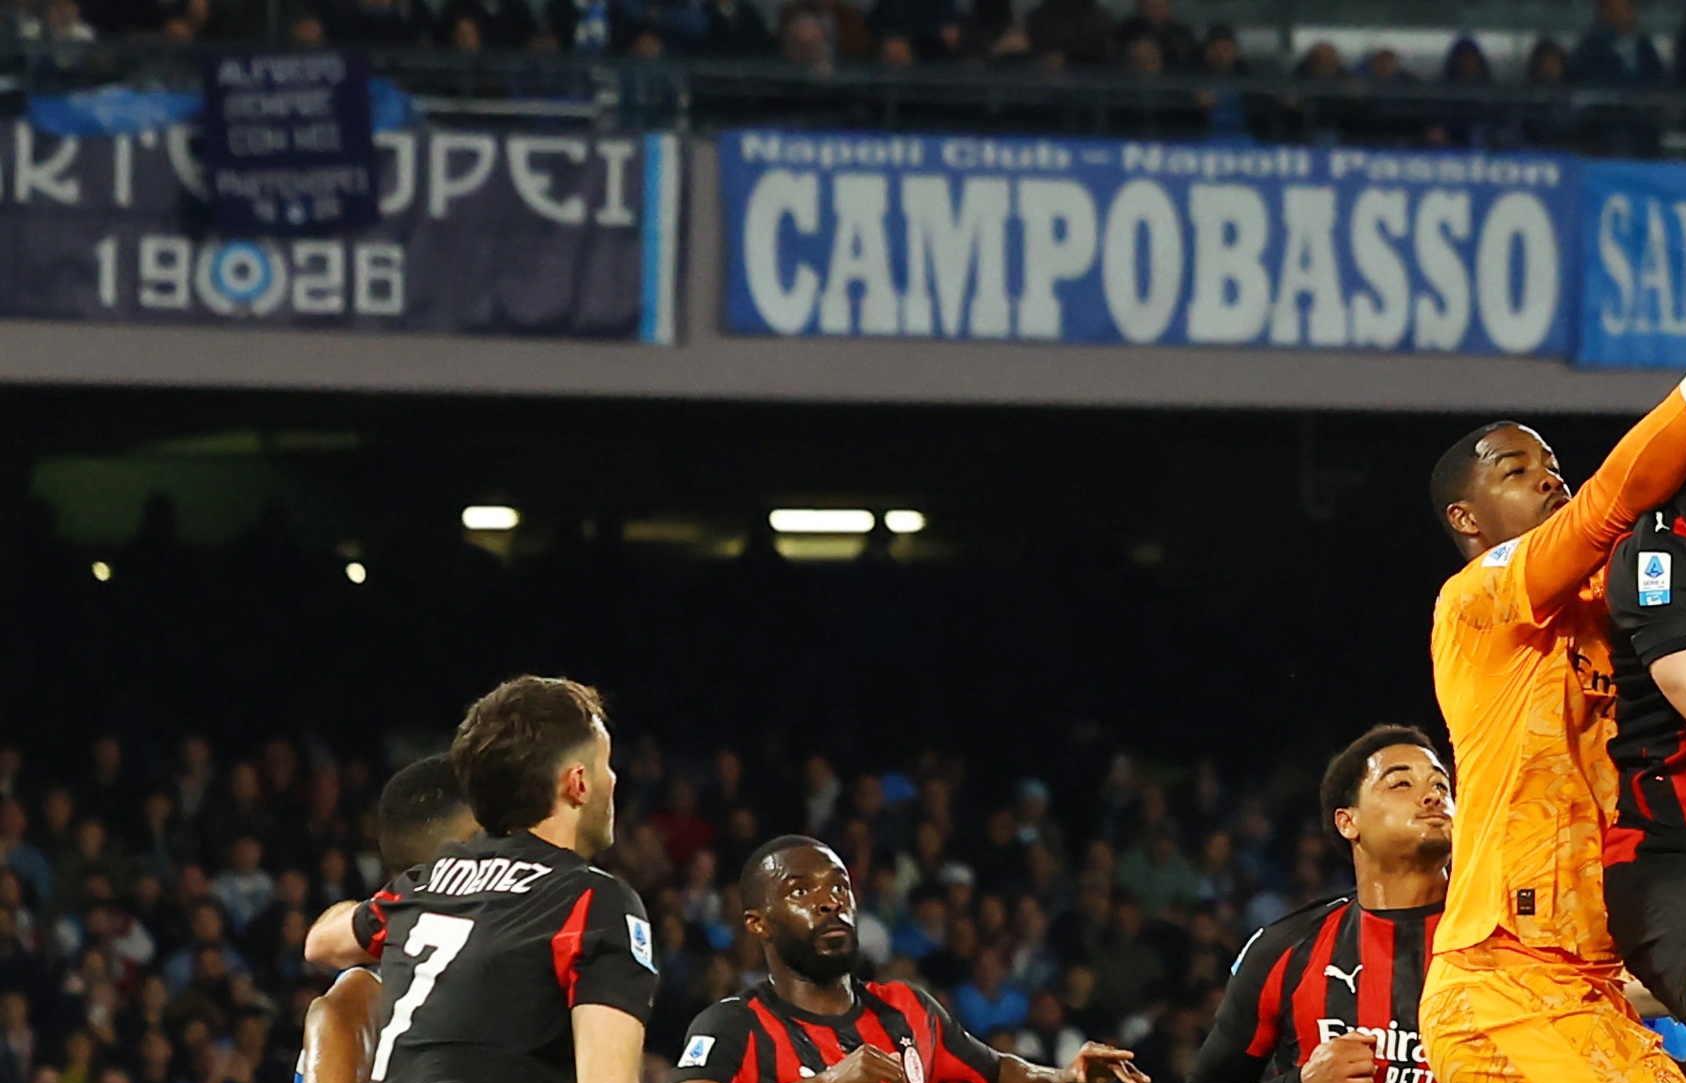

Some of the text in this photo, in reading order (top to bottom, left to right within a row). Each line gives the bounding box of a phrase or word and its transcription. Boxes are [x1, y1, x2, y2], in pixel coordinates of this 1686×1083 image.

[942, 137, 1072, 170] Club
[743, 167, 1560, 356] CAMPOBASSO
[371, 911, 476, 1083] 7
